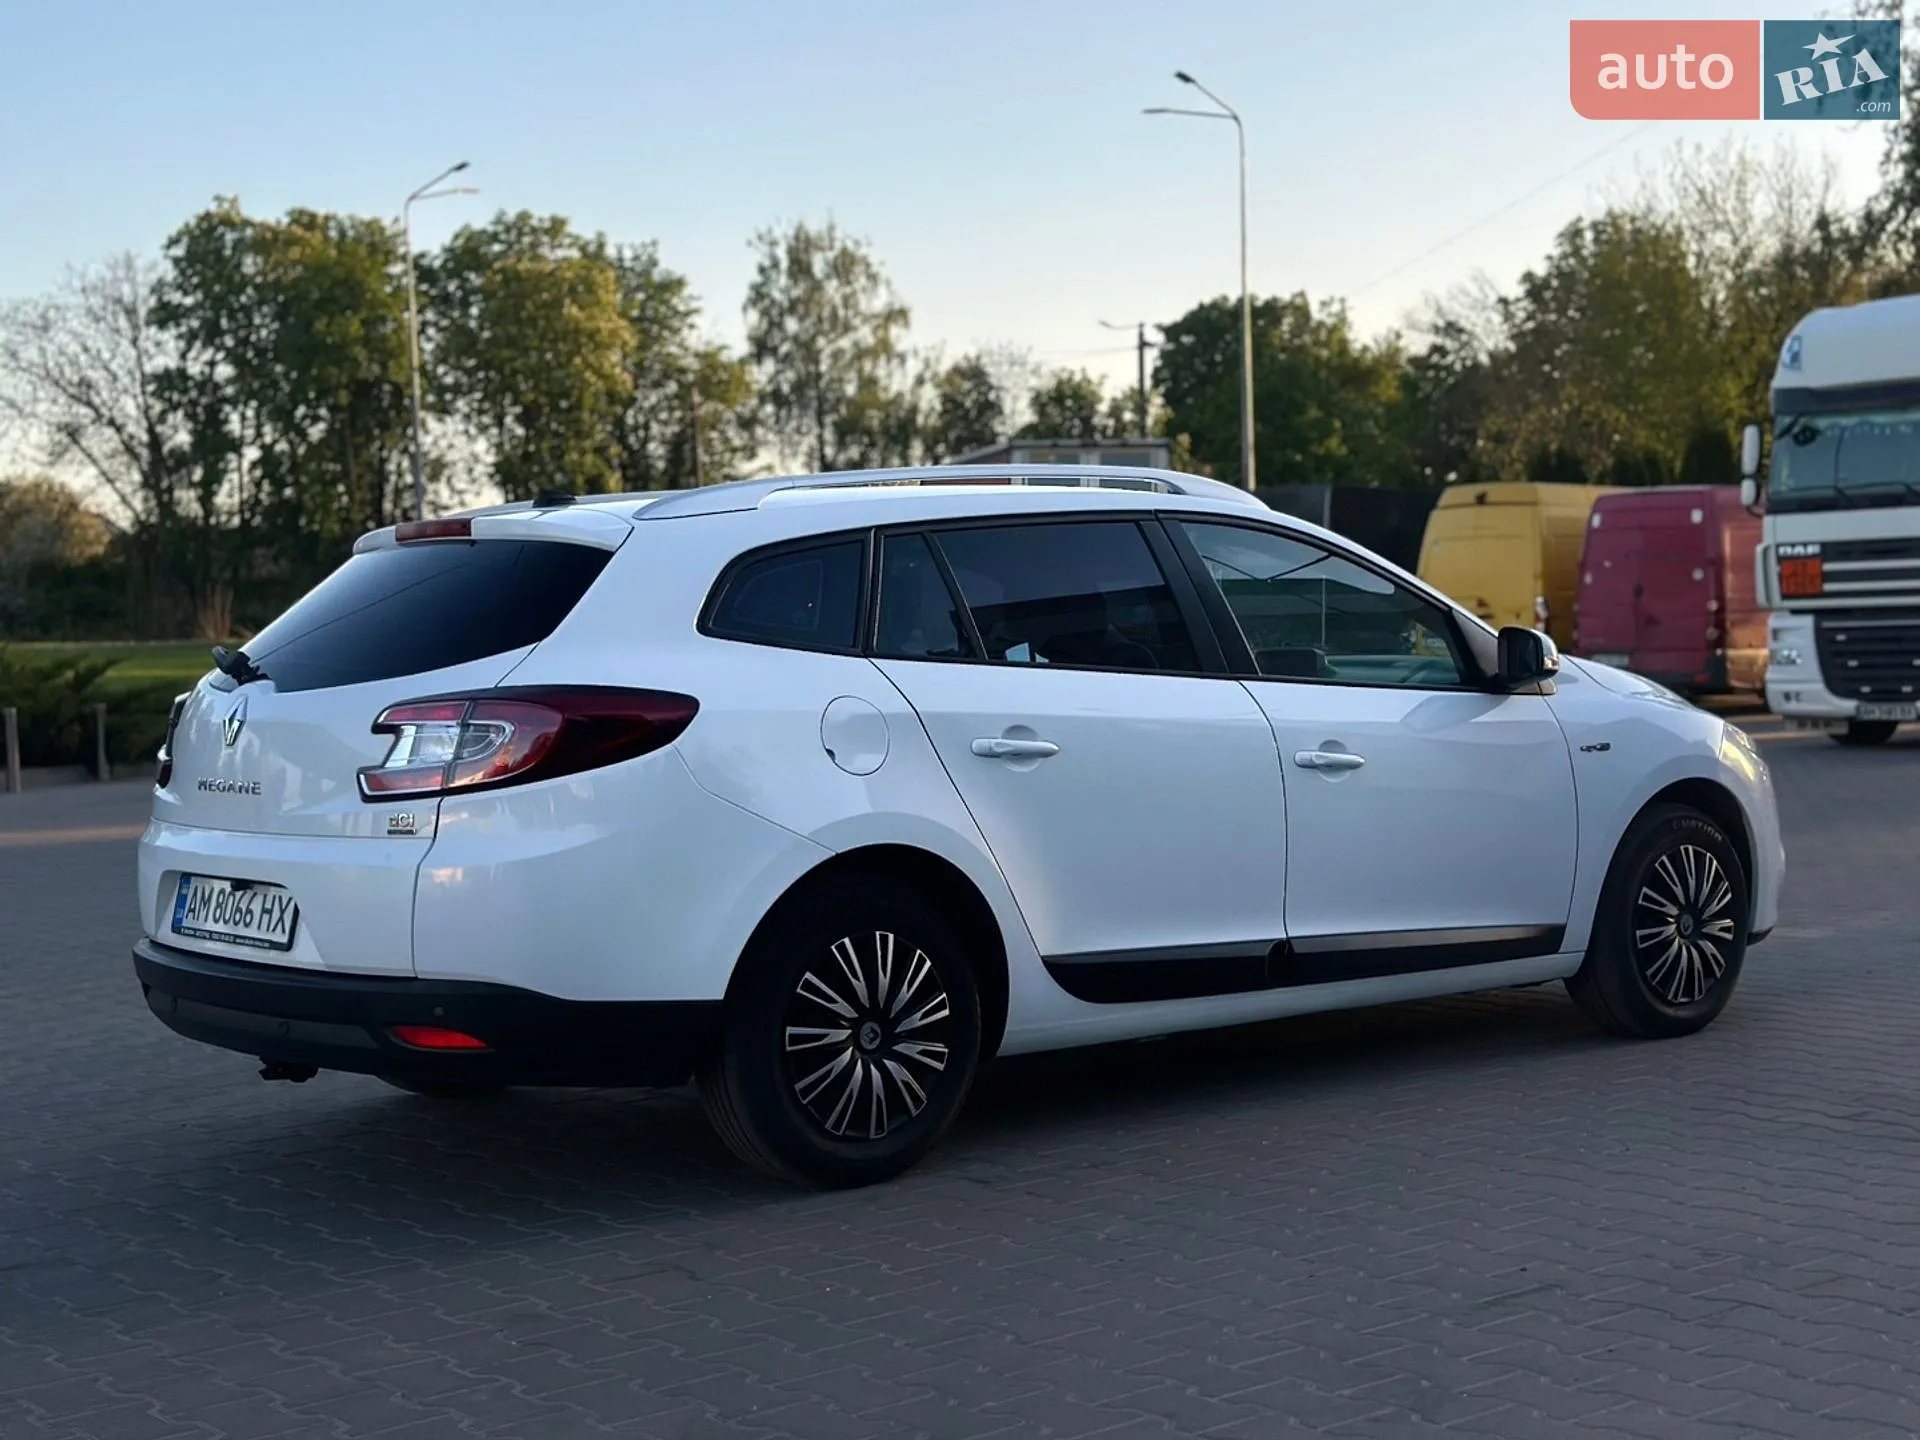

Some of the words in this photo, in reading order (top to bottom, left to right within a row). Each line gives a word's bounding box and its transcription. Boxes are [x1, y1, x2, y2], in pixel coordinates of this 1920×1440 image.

[185, 885, 215, 923] AM
[212, 887, 258, 929] 8066
[257, 892, 294, 935] HX
